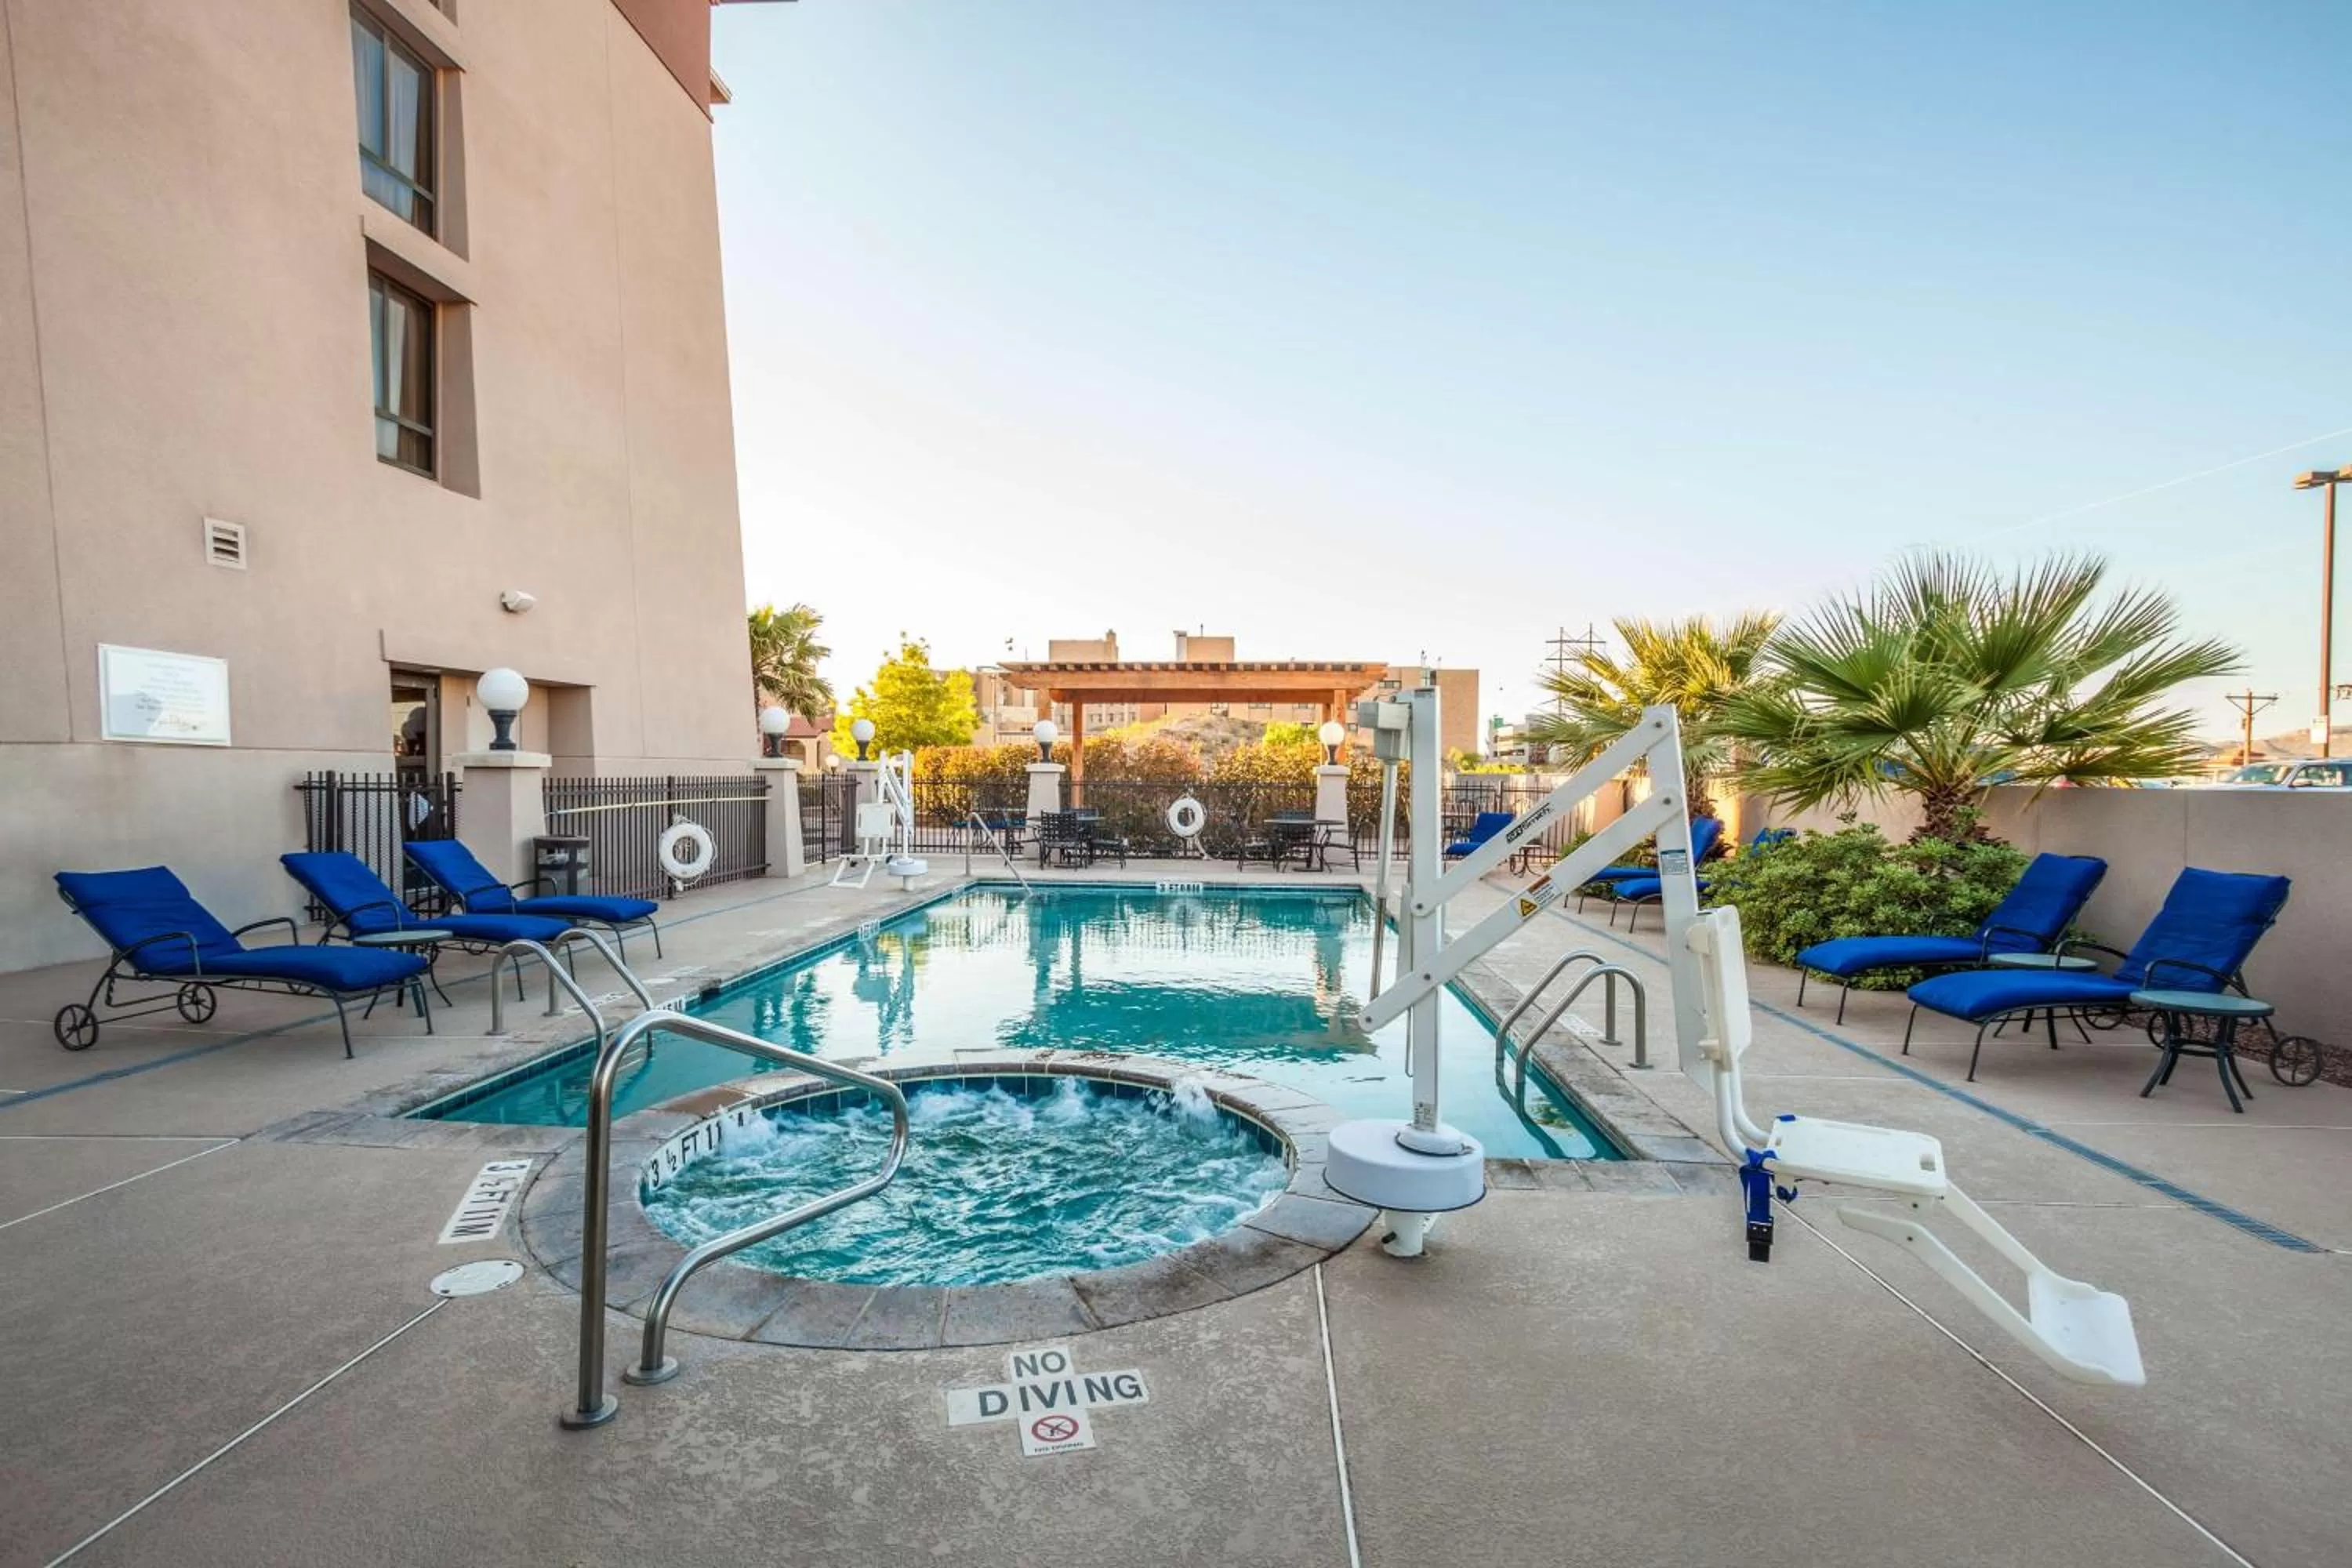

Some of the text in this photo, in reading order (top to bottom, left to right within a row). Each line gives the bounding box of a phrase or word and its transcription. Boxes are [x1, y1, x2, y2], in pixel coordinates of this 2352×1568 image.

[650, 1158, 659, 1187] 3
[681, 1131, 699, 1165] FT
[470, 1189, 513, 1203] FT
[1014, 1351, 1066, 1377] NO
[978, 1374, 1142, 1417] DIVING
